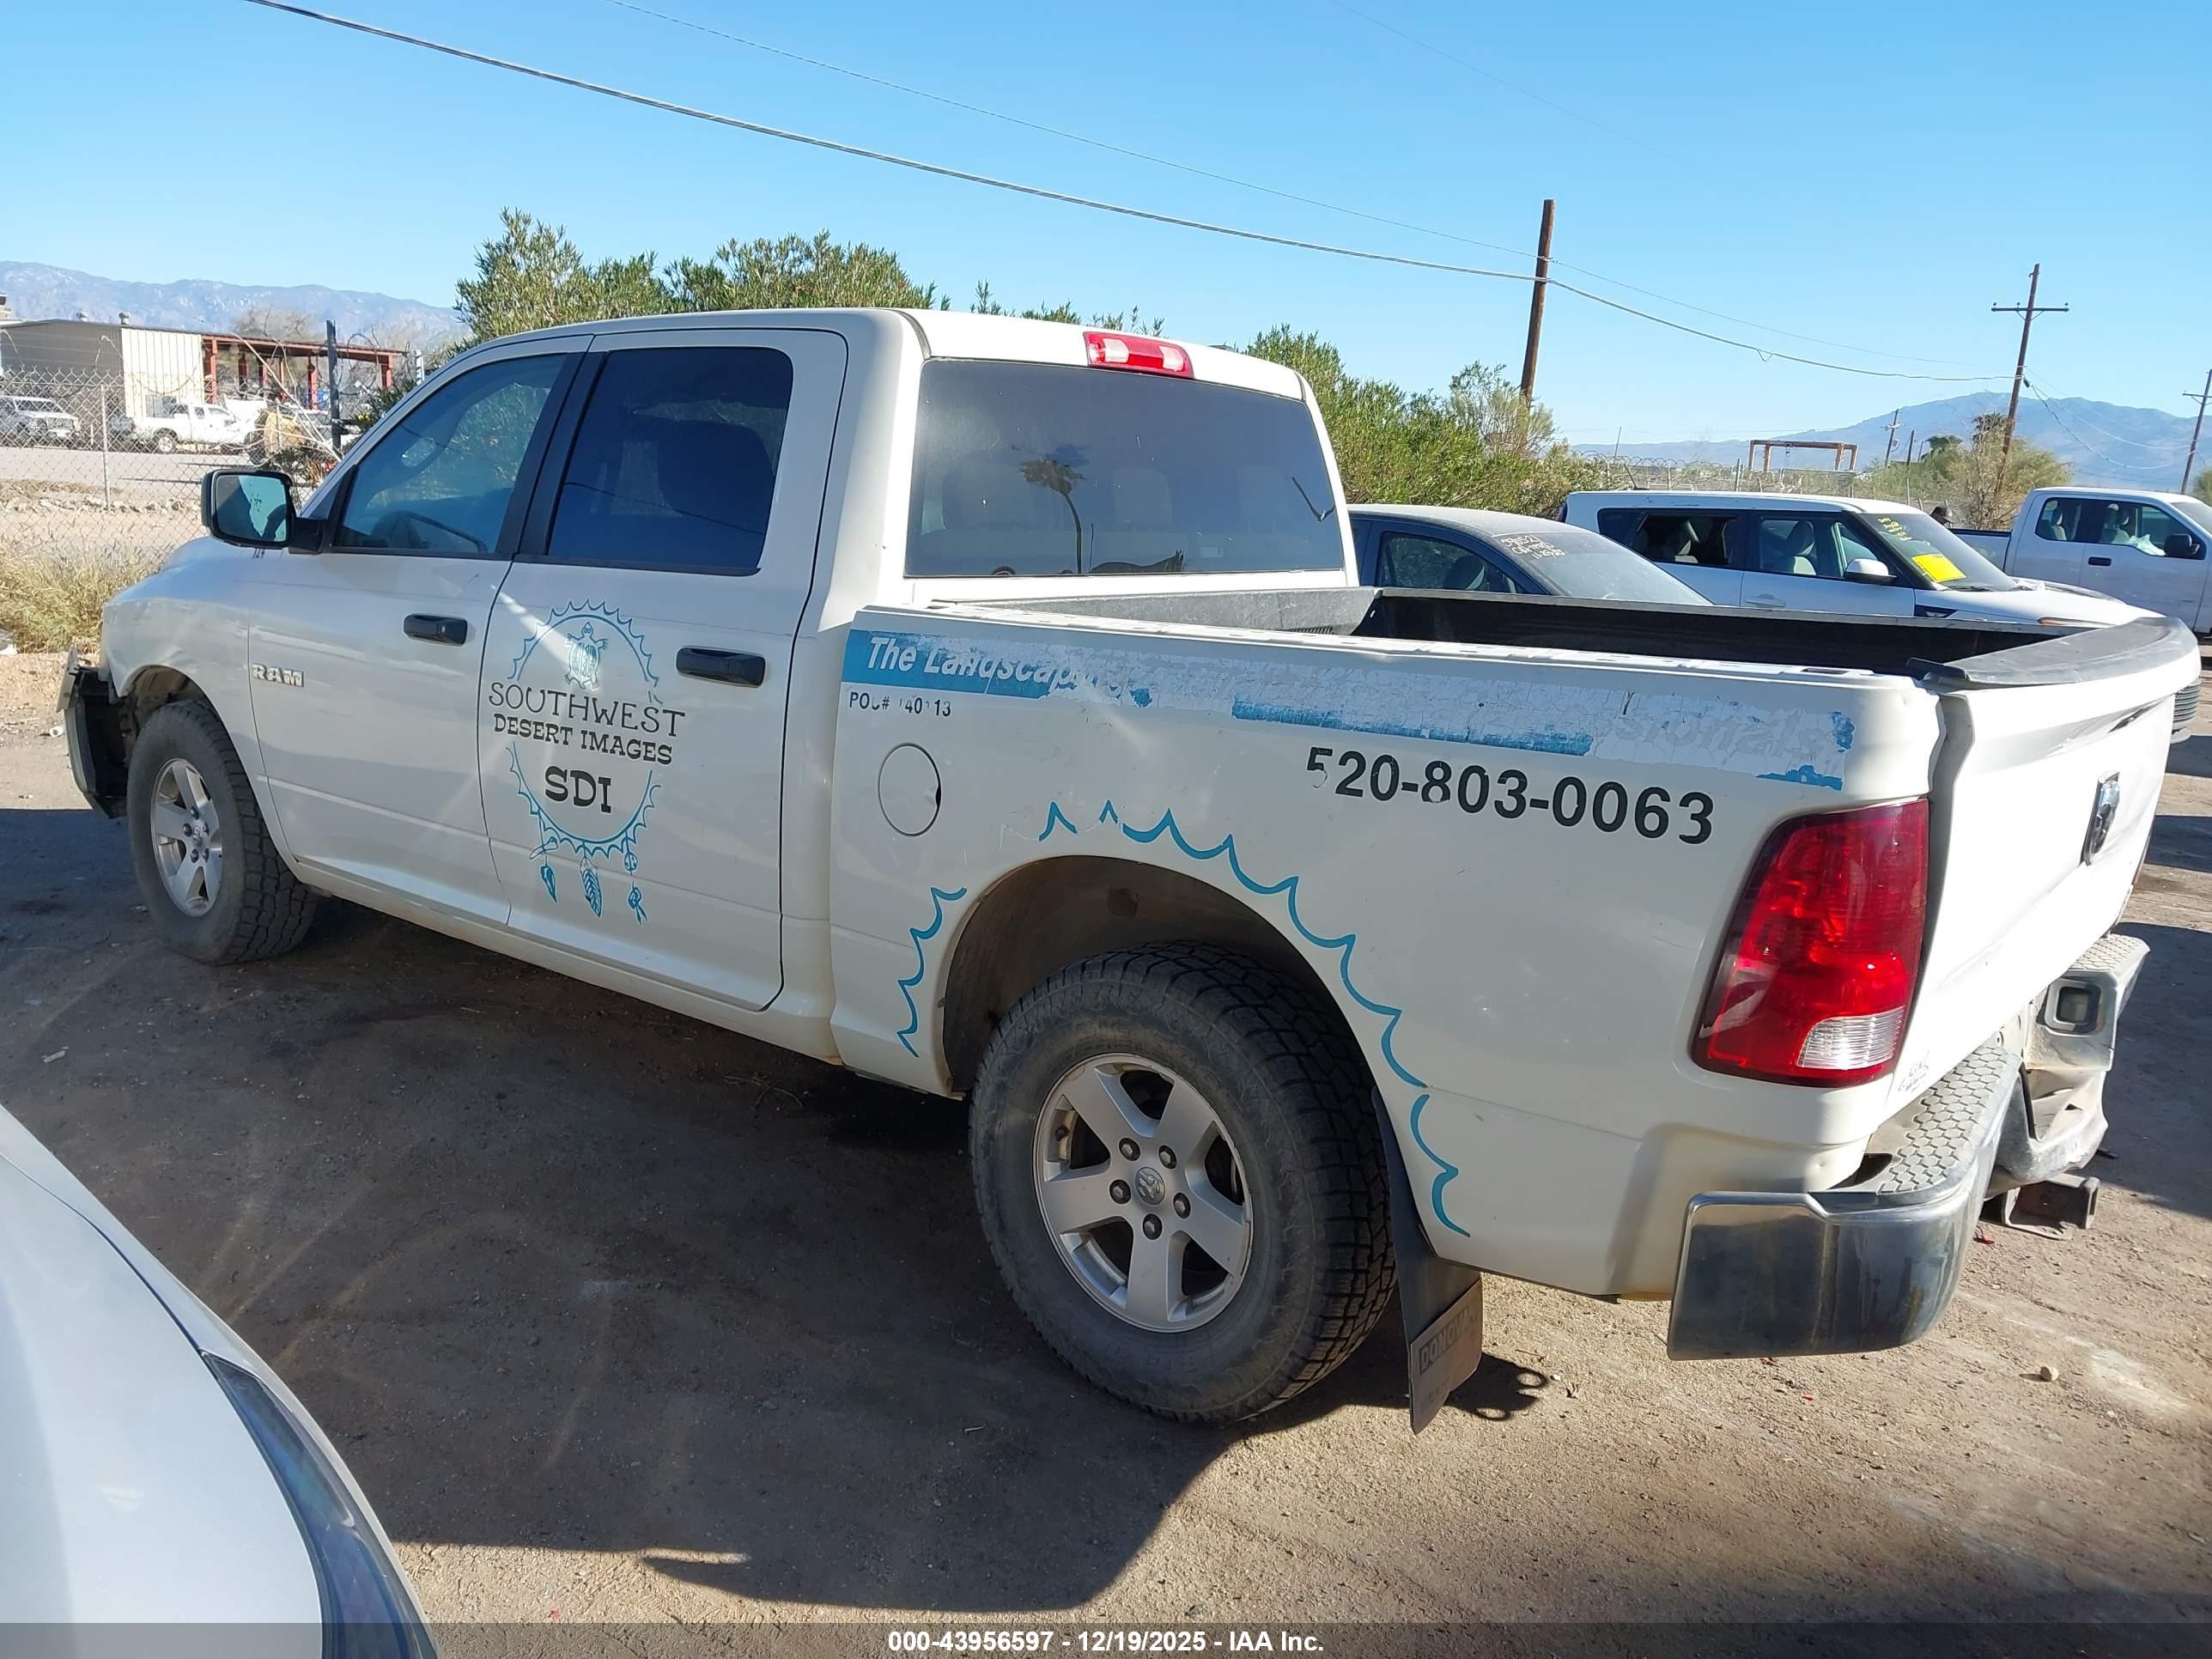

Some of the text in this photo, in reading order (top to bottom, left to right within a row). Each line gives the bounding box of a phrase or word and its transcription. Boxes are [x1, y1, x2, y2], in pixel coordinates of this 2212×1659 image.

[252, 662, 304, 688] RAM
[867, 636, 917, 672] The
[488, 682, 686, 738] SOUTHWEST
[899, 696, 951, 717] 4013
[494, 714, 673, 765] DESERT IMAGES
[544, 765, 612, 814] SDI
[1306, 746, 1715, 845] 520-803-0063
